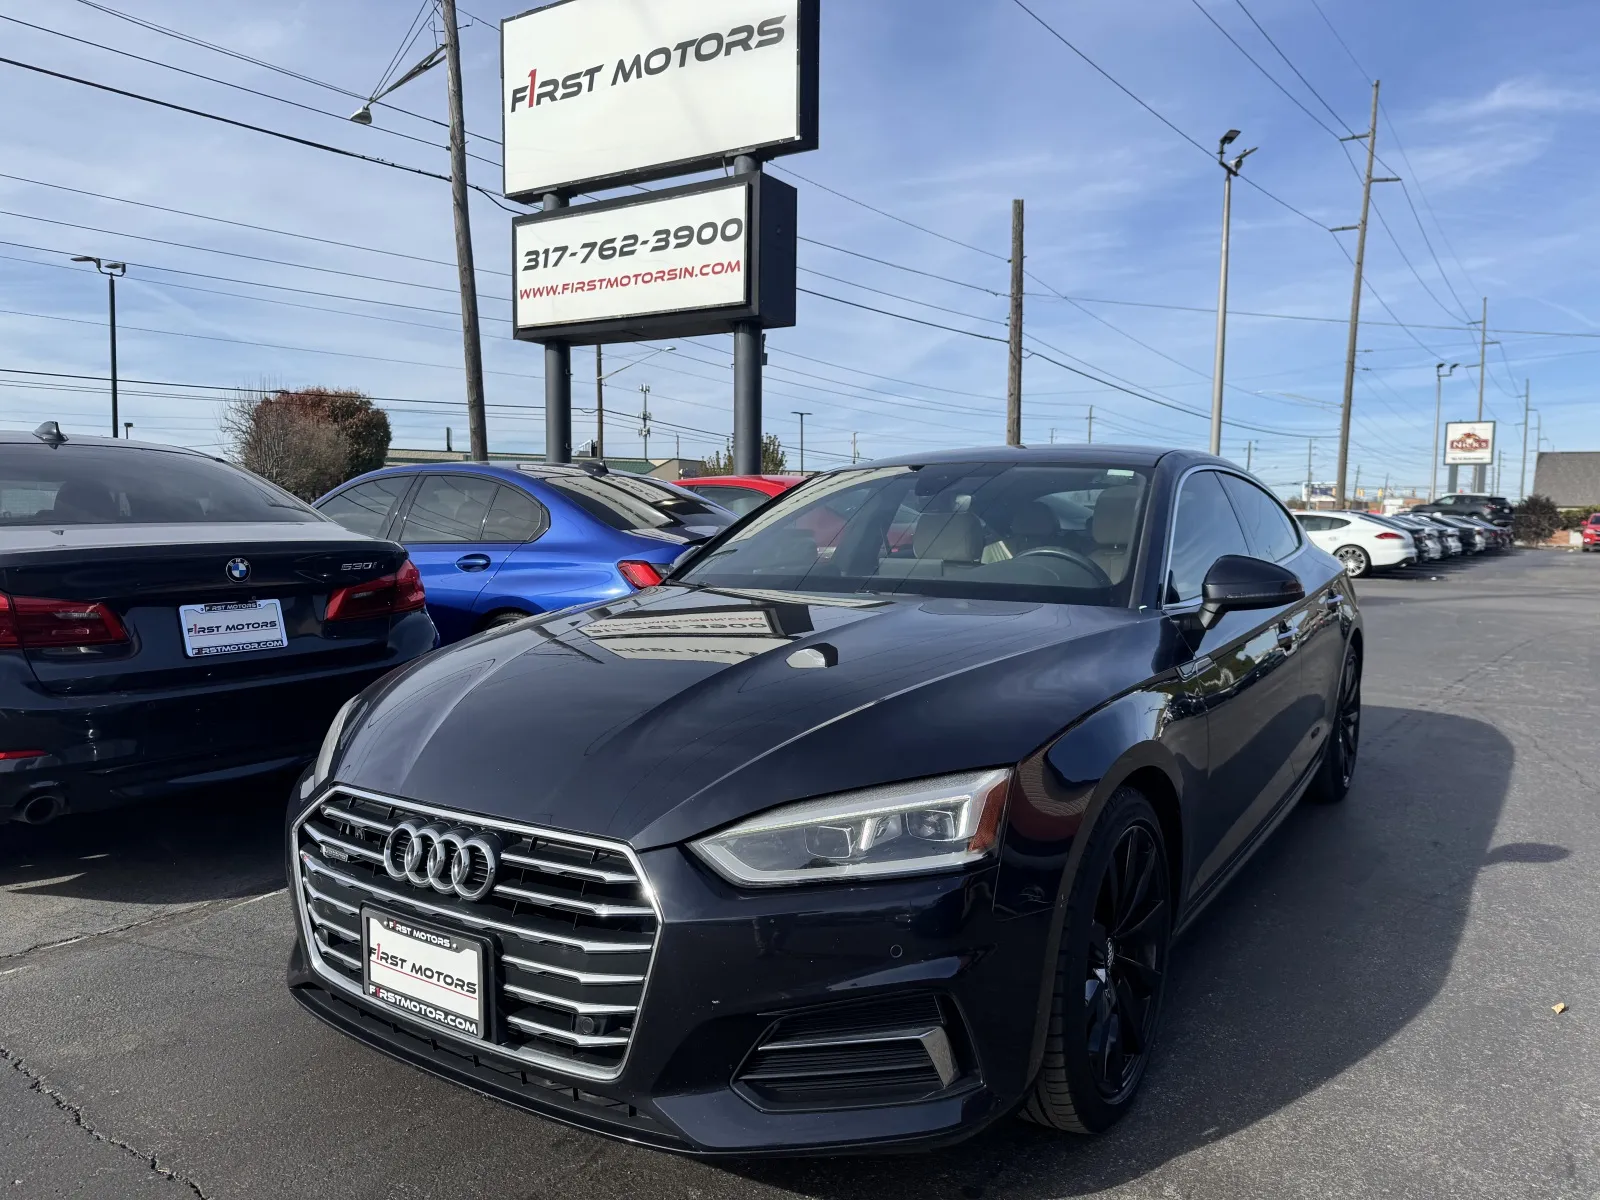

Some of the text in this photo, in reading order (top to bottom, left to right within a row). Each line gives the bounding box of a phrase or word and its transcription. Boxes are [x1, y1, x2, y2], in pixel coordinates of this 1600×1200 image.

[611, 15, 787, 86] MOTORS
[522, 218, 743, 272] 317-762-3900
[519, 260, 741, 300] WWW.FIRSTMOTORSIN.COM
[205, 602, 257, 612] FRST MOTORS
[225, 620, 277, 632] MOTORS
[412, 929, 451, 948] MOTORS
[410, 962, 477, 994] MOTORS
